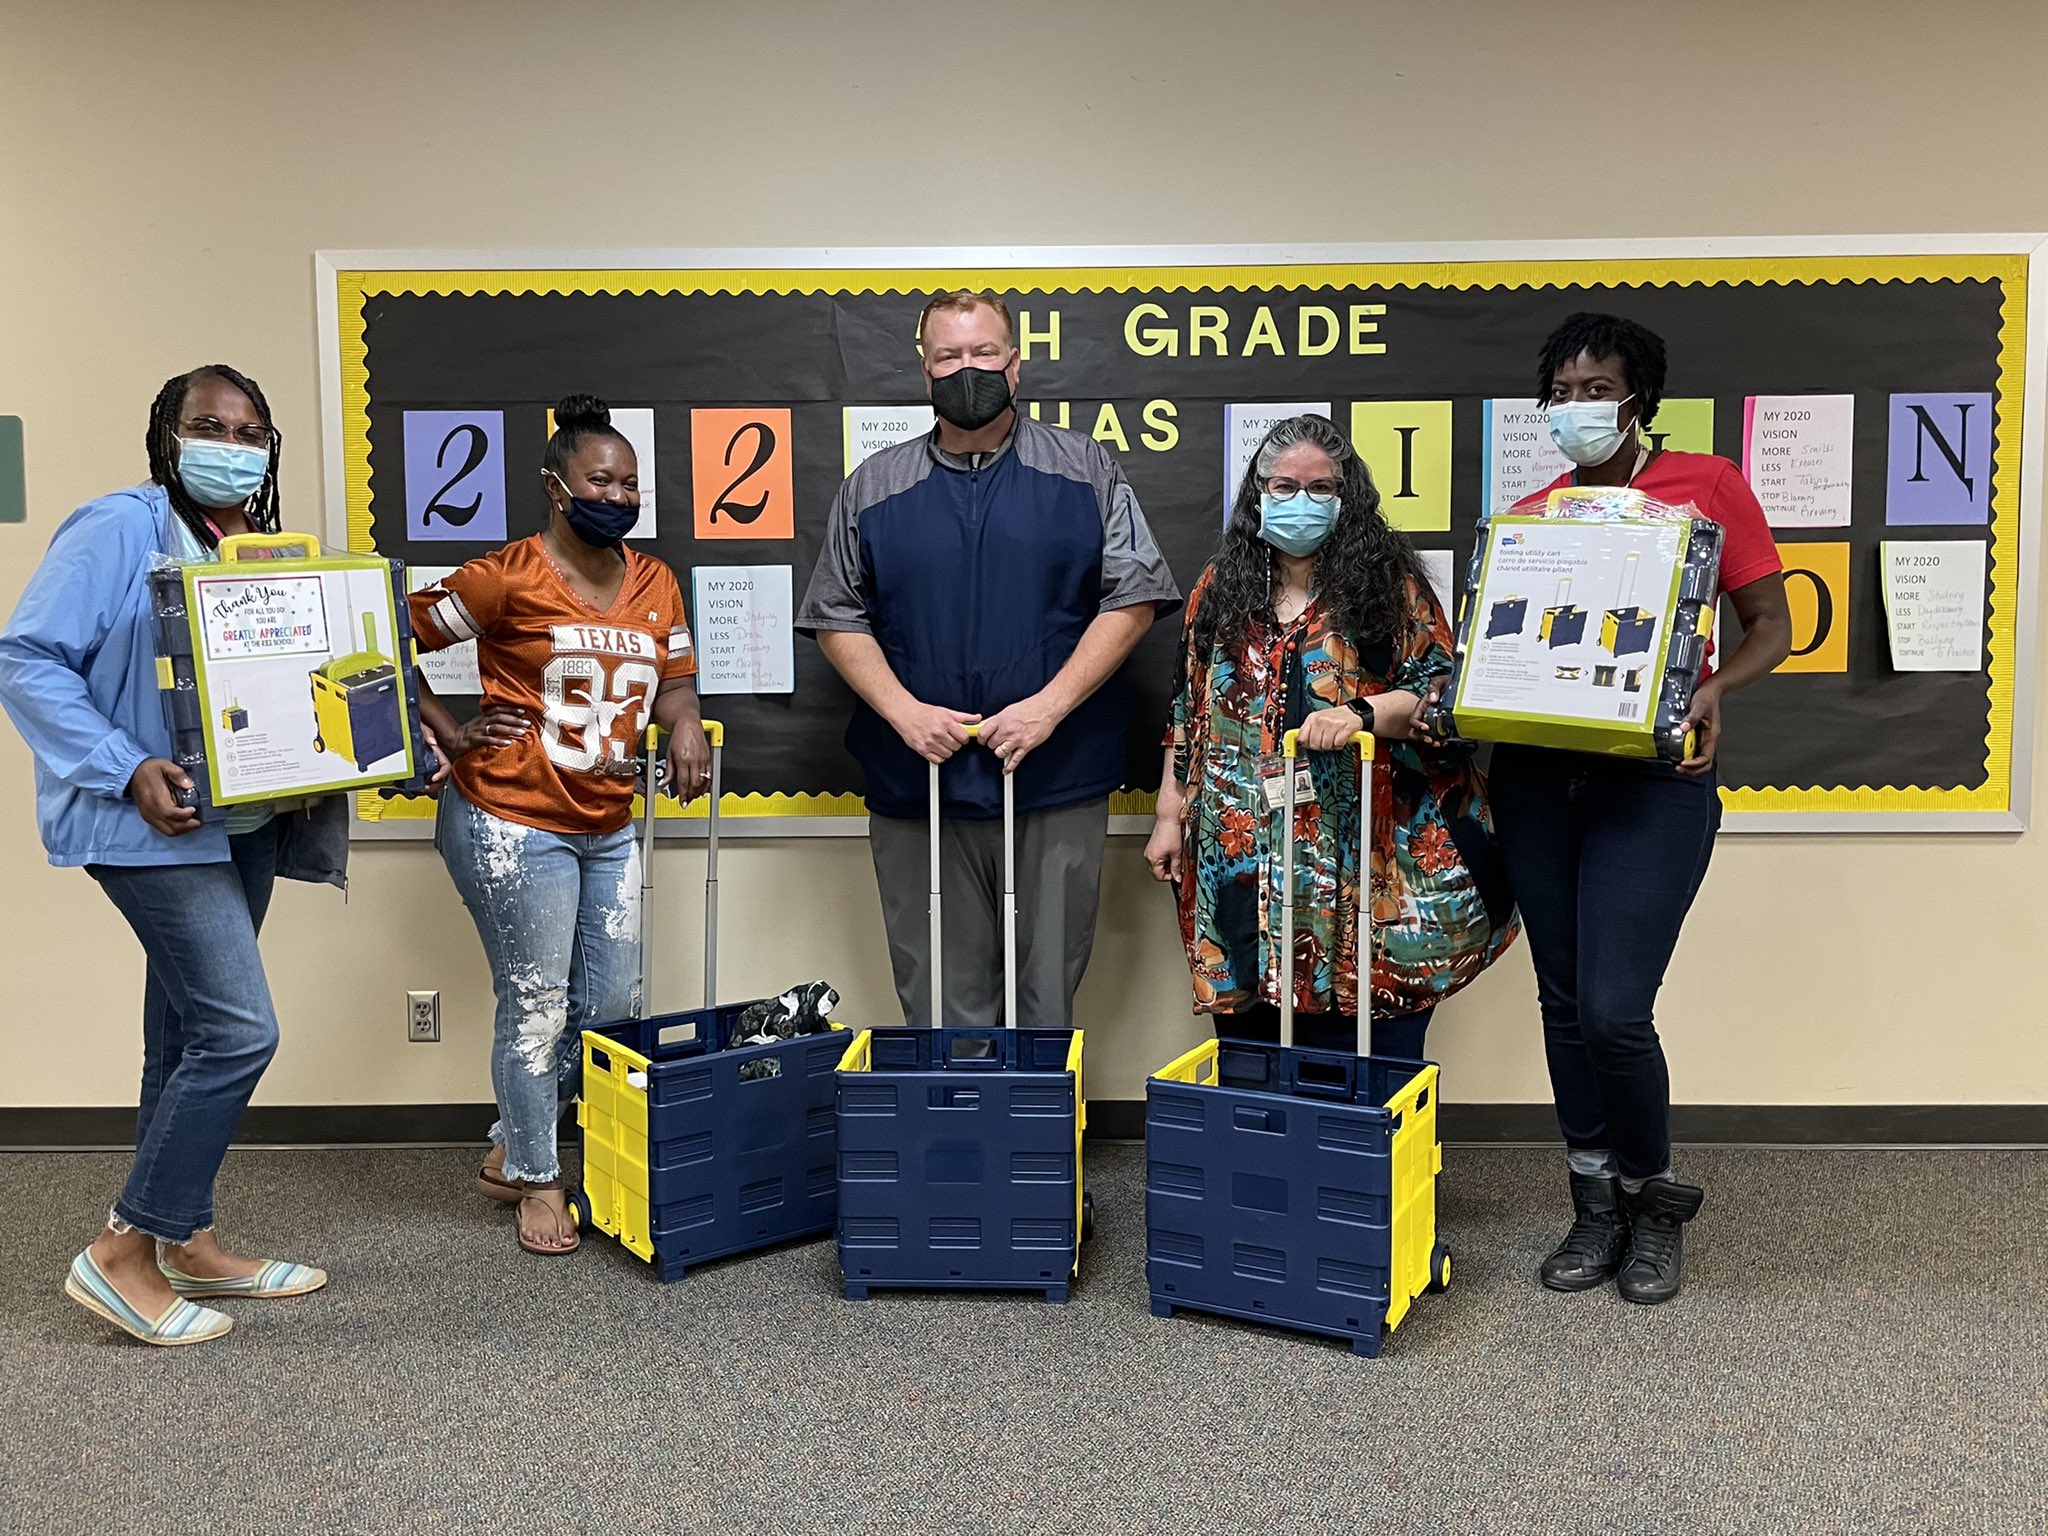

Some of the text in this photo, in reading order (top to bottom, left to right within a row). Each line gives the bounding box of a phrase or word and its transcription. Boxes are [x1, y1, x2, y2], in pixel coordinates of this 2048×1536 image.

[1124, 303, 1386, 357] GRADE
[1503, 414, 1550, 424] MY 2020
[1763, 410, 1811, 421] MY 2020
[862, 421, 908, 431] MY 2020
[1242, 419, 1259, 429] MY
[1502, 432, 1538, 441] VISION
[1762, 430, 1798, 439] VISION
[861, 440, 896, 449] VISION
[1502, 450, 1531, 458] MORE
[1761, 447, 1791, 456] MORE
[1906, 404, 1975, 502] N
[1393, 427, 1420, 498] I
[1502, 466, 1522, 474] LESS
[1761, 463, 1781, 472] LESS
[423, 424, 488, 526] 2
[710, 422, 775, 524] 2
[1502, 480, 1526, 489] START
[1761, 478, 1786, 486] START
[1761, 492, 1779, 500] STOP
[1499, 549, 1523, 557] folding
[1525, 549, 1545, 557] utility
[1556, 558, 1588, 567] plegable
[1895, 556, 1940, 567] MY 2020
[1522, 565, 1551, 573] utilitaire
[1552, 566, 1574, 574] pliant
[1895, 575, 1926, 584] VISION
[708, 581, 754, 591] MY 2020
[1895, 592, 1920, 600] MORE
[213, 586, 287, 619] Thank You
[708, 599, 744, 608] VISION
[244, 608, 255, 616] FOR
[255, 607, 265, 615] ALL
[1896, 607, 1911, 616] LESS
[256, 617, 266, 625] YOU
[709, 616, 738, 625] MORE
[1896, 622, 1916, 630] START
[223, 624, 312, 641] GREATLY APPRECIATED
[709, 632, 729, 640] LESS
[251, 640, 261, 648] THE
[574, 627, 642, 654] TEXAS
[1898, 636, 1911, 644] STOP
[710, 646, 735, 654] START
[426, 660, 446, 668] STOP
[562, 660, 591, 674] 1883
[710, 660, 730, 668] STOP
[711, 672, 747, 680] CONTINUE
